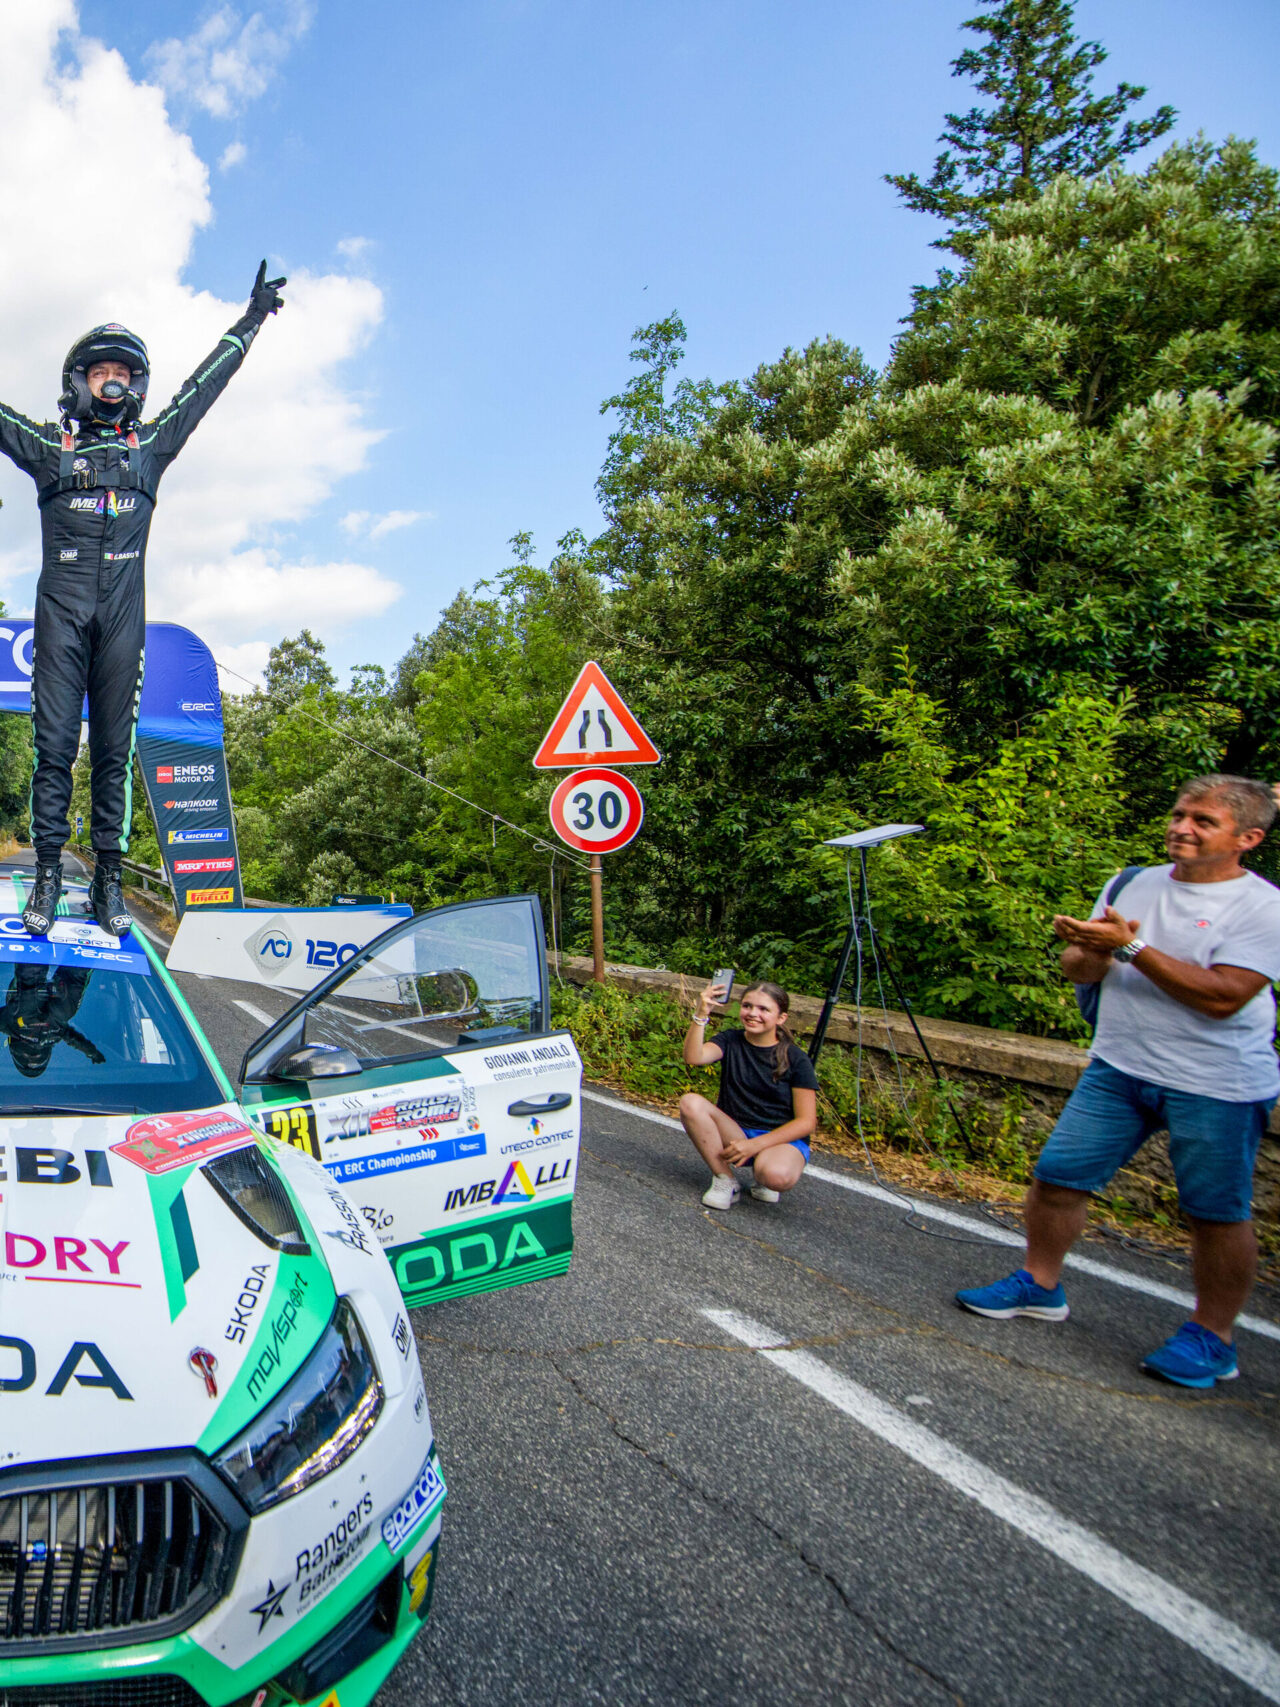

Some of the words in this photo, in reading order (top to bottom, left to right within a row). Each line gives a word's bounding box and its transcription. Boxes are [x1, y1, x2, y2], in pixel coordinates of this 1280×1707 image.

[60, 551, 78, 560] OMP
[181, 703, 215, 711] ERC
[174, 765, 215, 776] ENEOS
[572, 790, 621, 831] 30
[177, 863, 205, 871] MRF
[206, 861, 233, 869] TYRES
[191, 891, 230, 903] PIRELLI
[23, 913, 47, 926] OMP
[53, 936, 116, 948] SPORT
[260, 938, 293, 959] ACI
[81, 950, 134, 963] ERC
[483, 1050, 532, 1070] GIOVANNI
[531, 1042, 571, 1060] ANDALÒ
[493, 1067, 533, 1081] consulente
[533, 1060, 577, 1076] patrimoniale
[395, 1095, 450, 1112] RALLY
[396, 1101, 462, 1124] ROMA
[271, 1107, 313, 1158] 23
[500, 1139, 535, 1155] UTECO
[535, 1130, 574, 1146] CONTEC
[345, 1161, 365, 1175] ERC
[367, 1148, 437, 1171] Championship
[443, 1159, 572, 1212] IMBALLI
[388, 1221, 548, 1292] ODA
[225, 1264, 271, 1344] SKODA
[395, 1318, 409, 1354] OMP
[382, 1465, 438, 1542] sparco
[296, 1492, 373, 1582] Rangers
